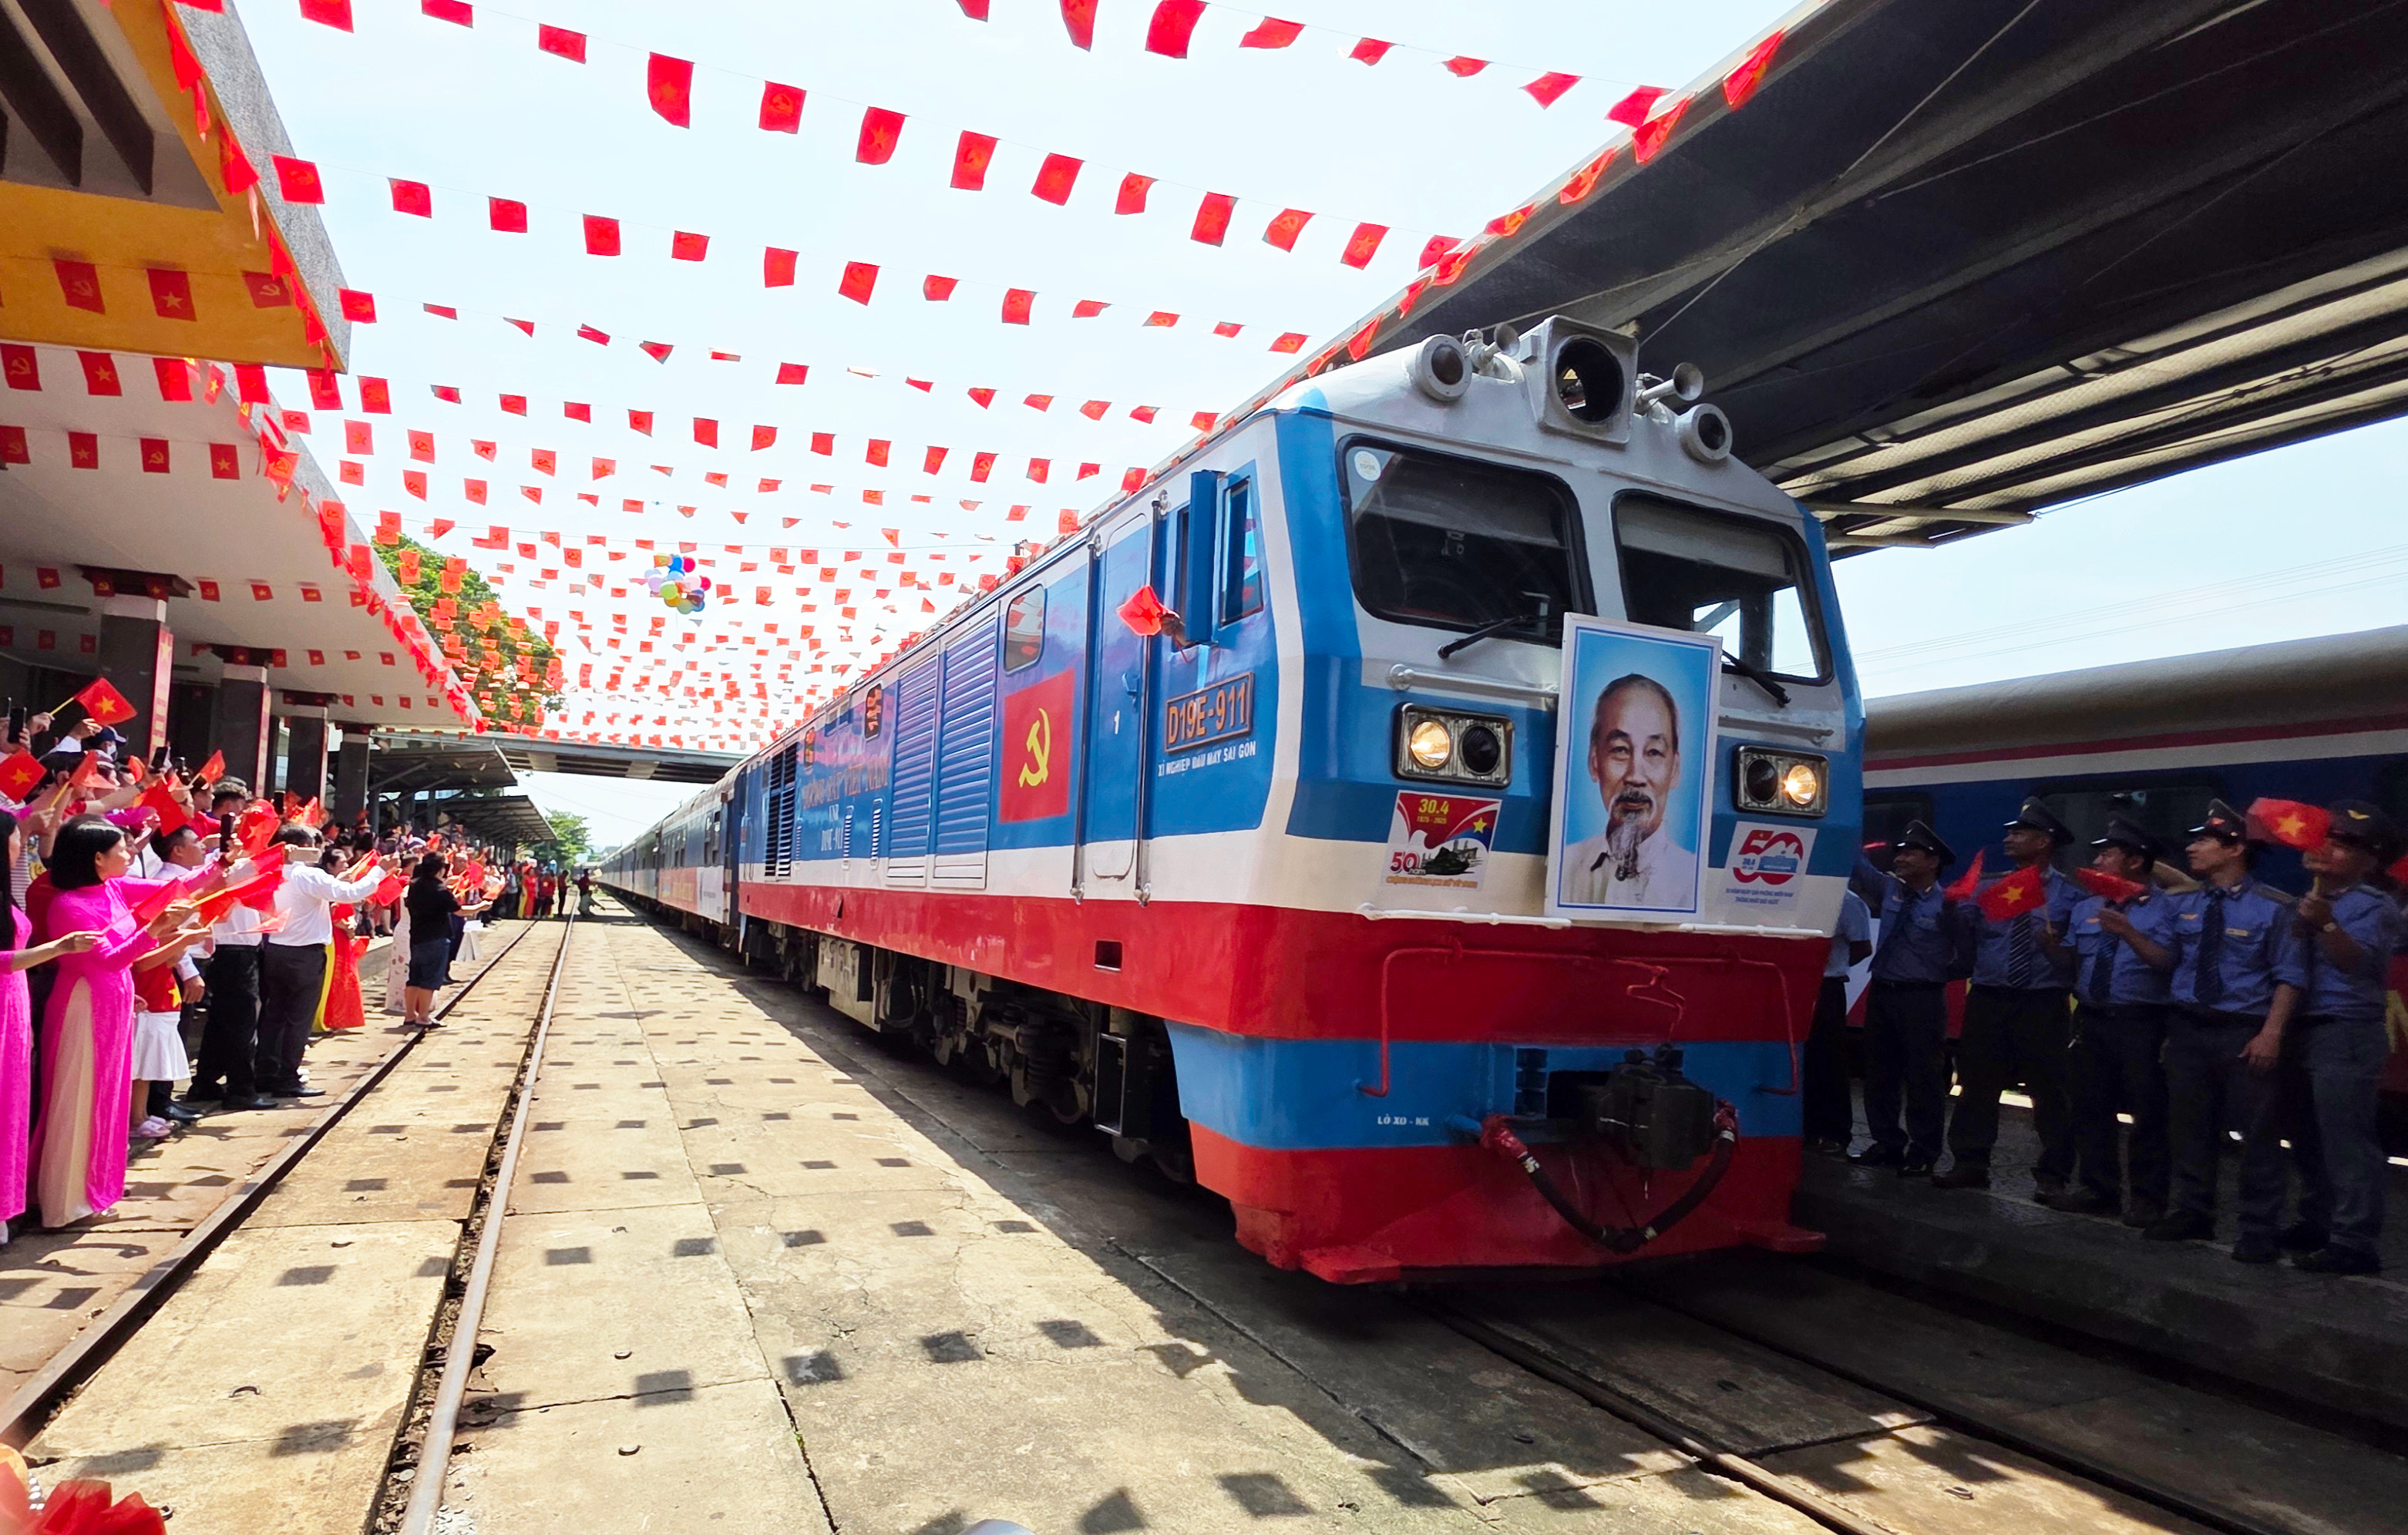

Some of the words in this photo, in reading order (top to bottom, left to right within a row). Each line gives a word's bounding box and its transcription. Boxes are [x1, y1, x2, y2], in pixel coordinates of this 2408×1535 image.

[1114, 710, 1120, 734] 1
[1168, 683, 1246, 744] D19E-911
[1239, 738, 1256, 758] GÒN
[1418, 798, 1449, 815] 30.4
[1390, 850, 1420, 873] 50
[1733, 830, 1804, 885] 50
[1377, 1113, 1391, 1125] LÒ
[1393, 1116, 1407, 1125] XO
